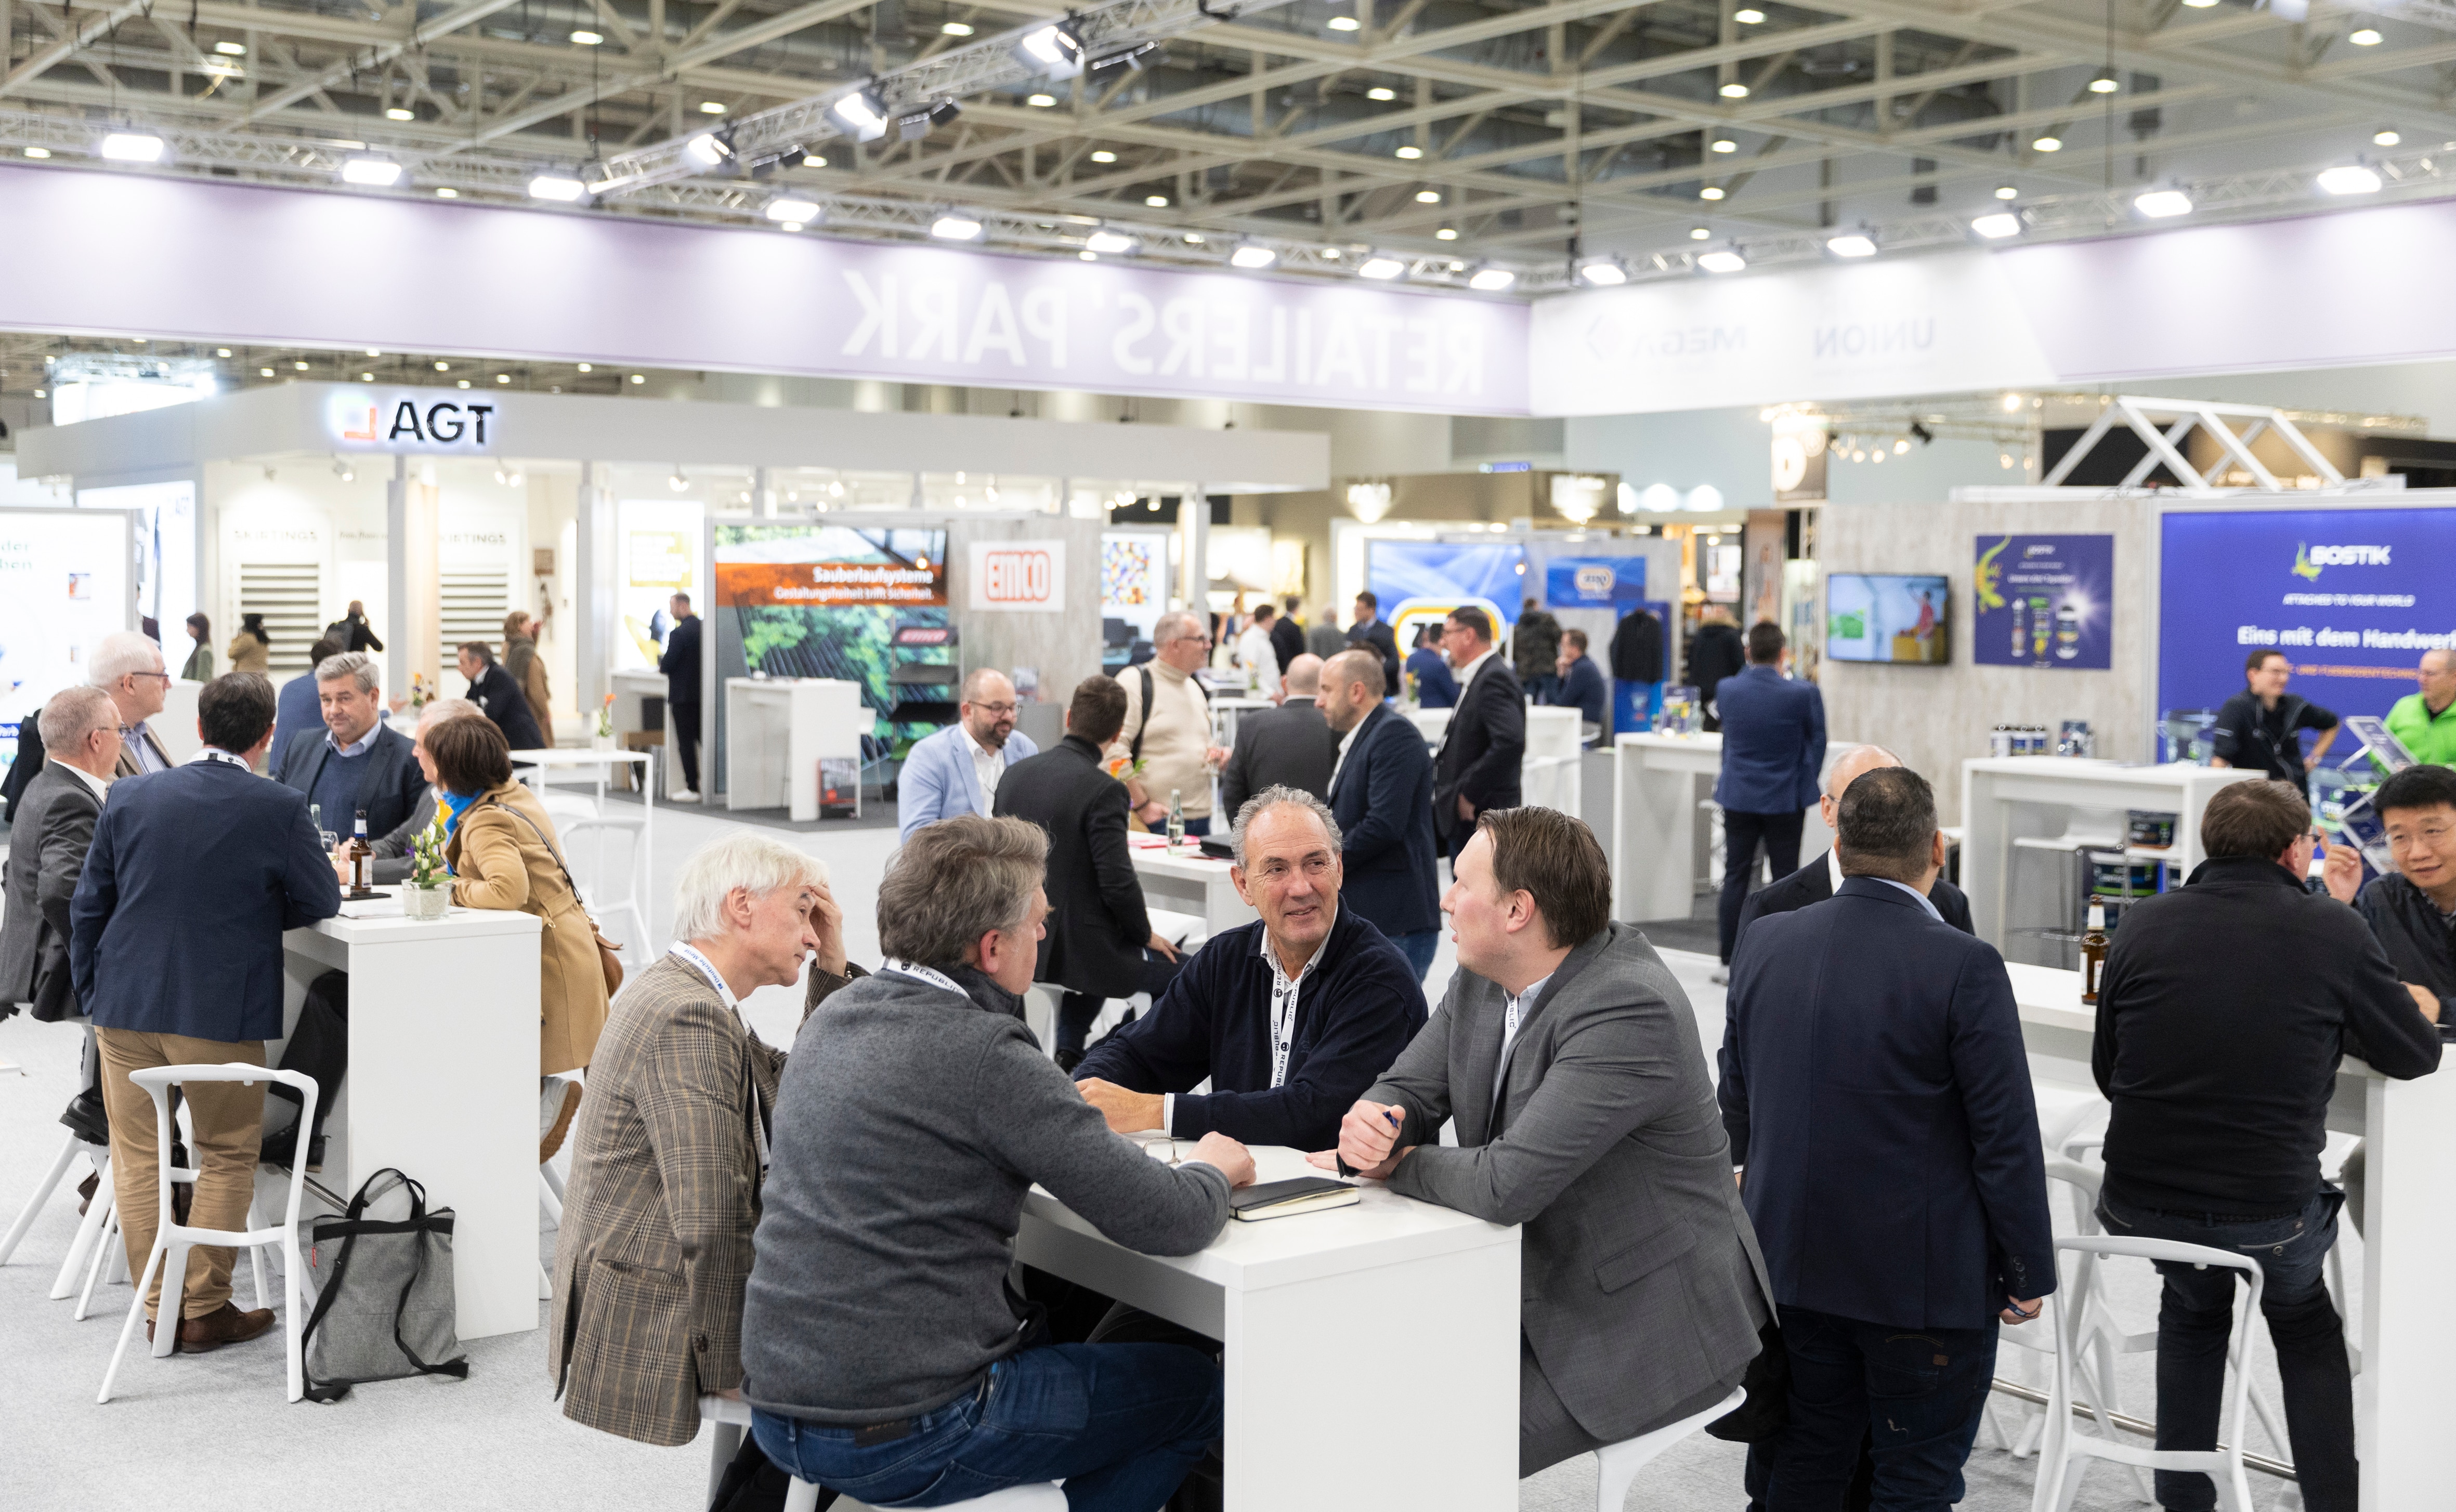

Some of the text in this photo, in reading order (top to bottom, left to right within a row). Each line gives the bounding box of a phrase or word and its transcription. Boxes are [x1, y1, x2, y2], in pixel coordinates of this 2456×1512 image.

[388, 401, 493, 445] AGT
[2309, 545, 2392, 566] BOSTIK
[813, 566, 934, 587] Sauberlaufsysteme
[774, 586, 864, 602] Gestaltungsfreiheit
[2237, 625, 2278, 645] Eins
[2280, 626, 2314, 646] mit
[2315, 627, 2360, 647] dem
[684, 949, 720, 983] Deutsche Messe
